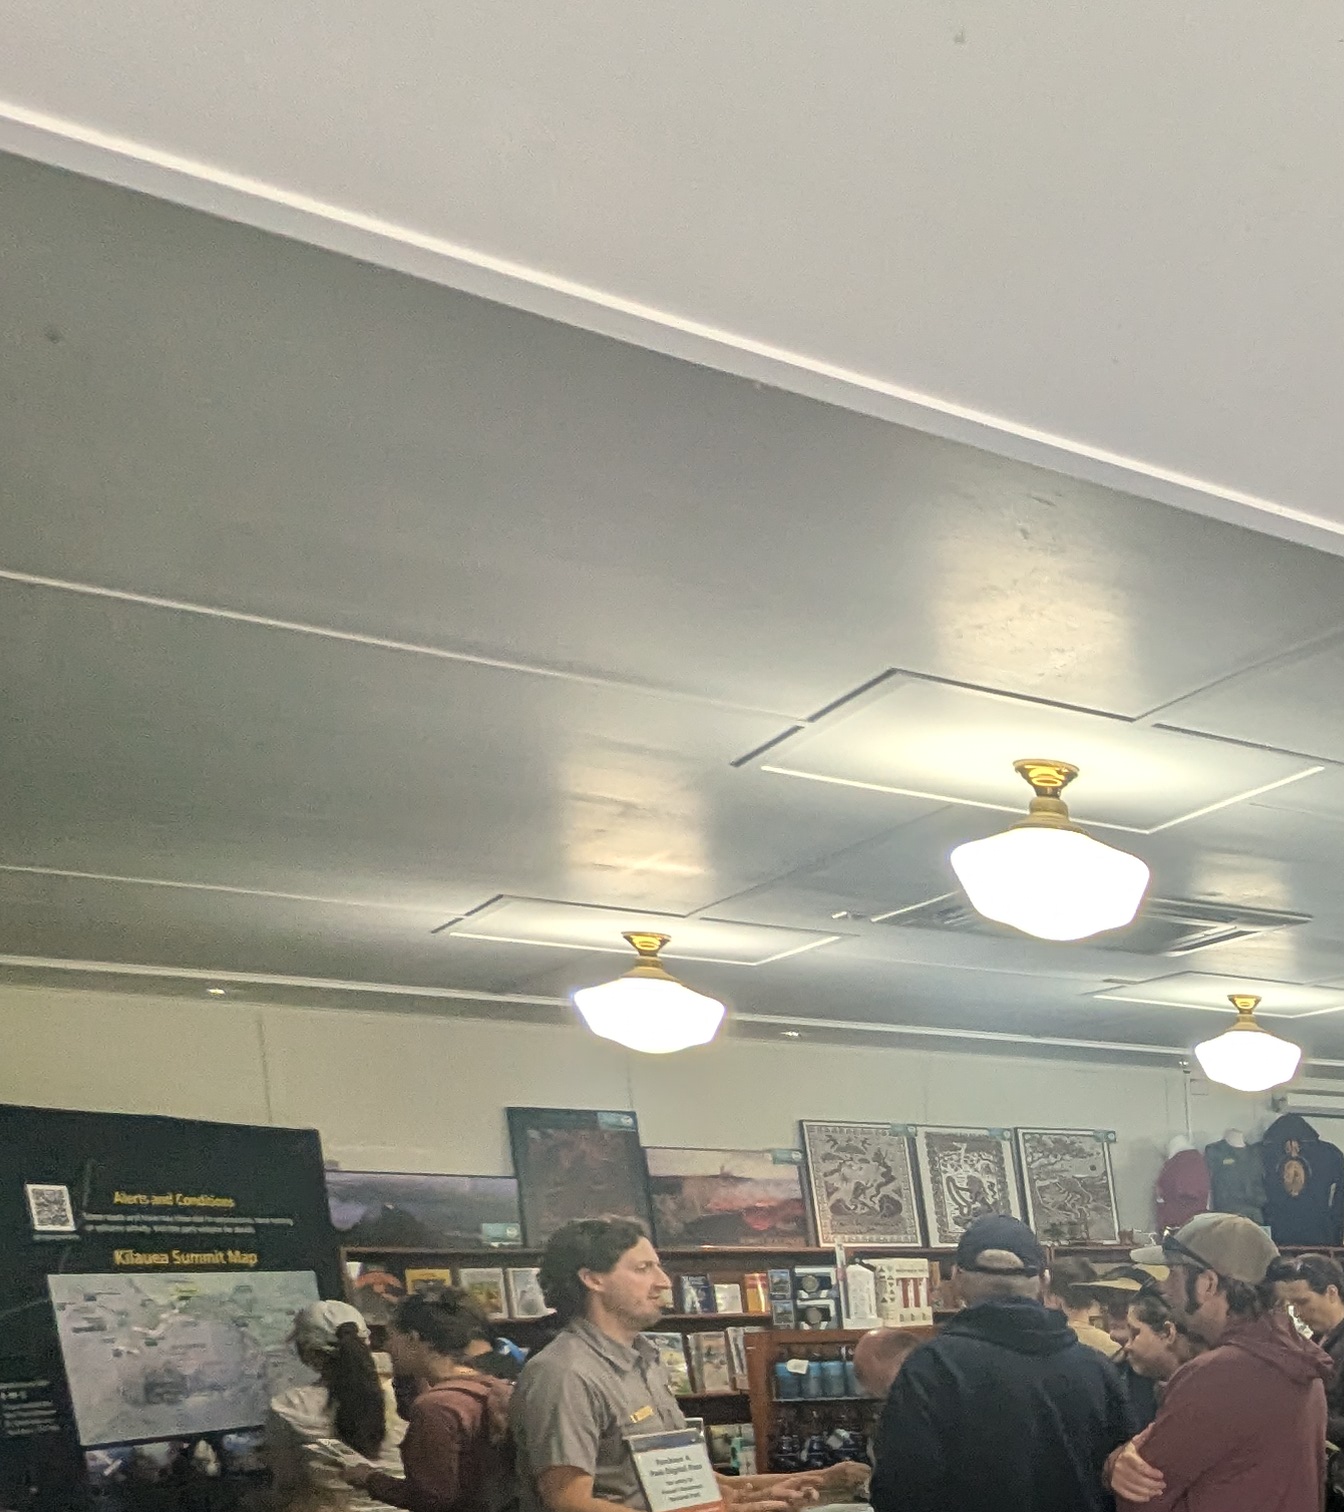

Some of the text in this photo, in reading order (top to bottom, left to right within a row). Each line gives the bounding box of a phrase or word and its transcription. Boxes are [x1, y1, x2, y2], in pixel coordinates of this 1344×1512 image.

[151, 1192, 174, 1205] and
[171, 1250, 226, 1264] Summit
[227, 1250, 258, 1267] Map
